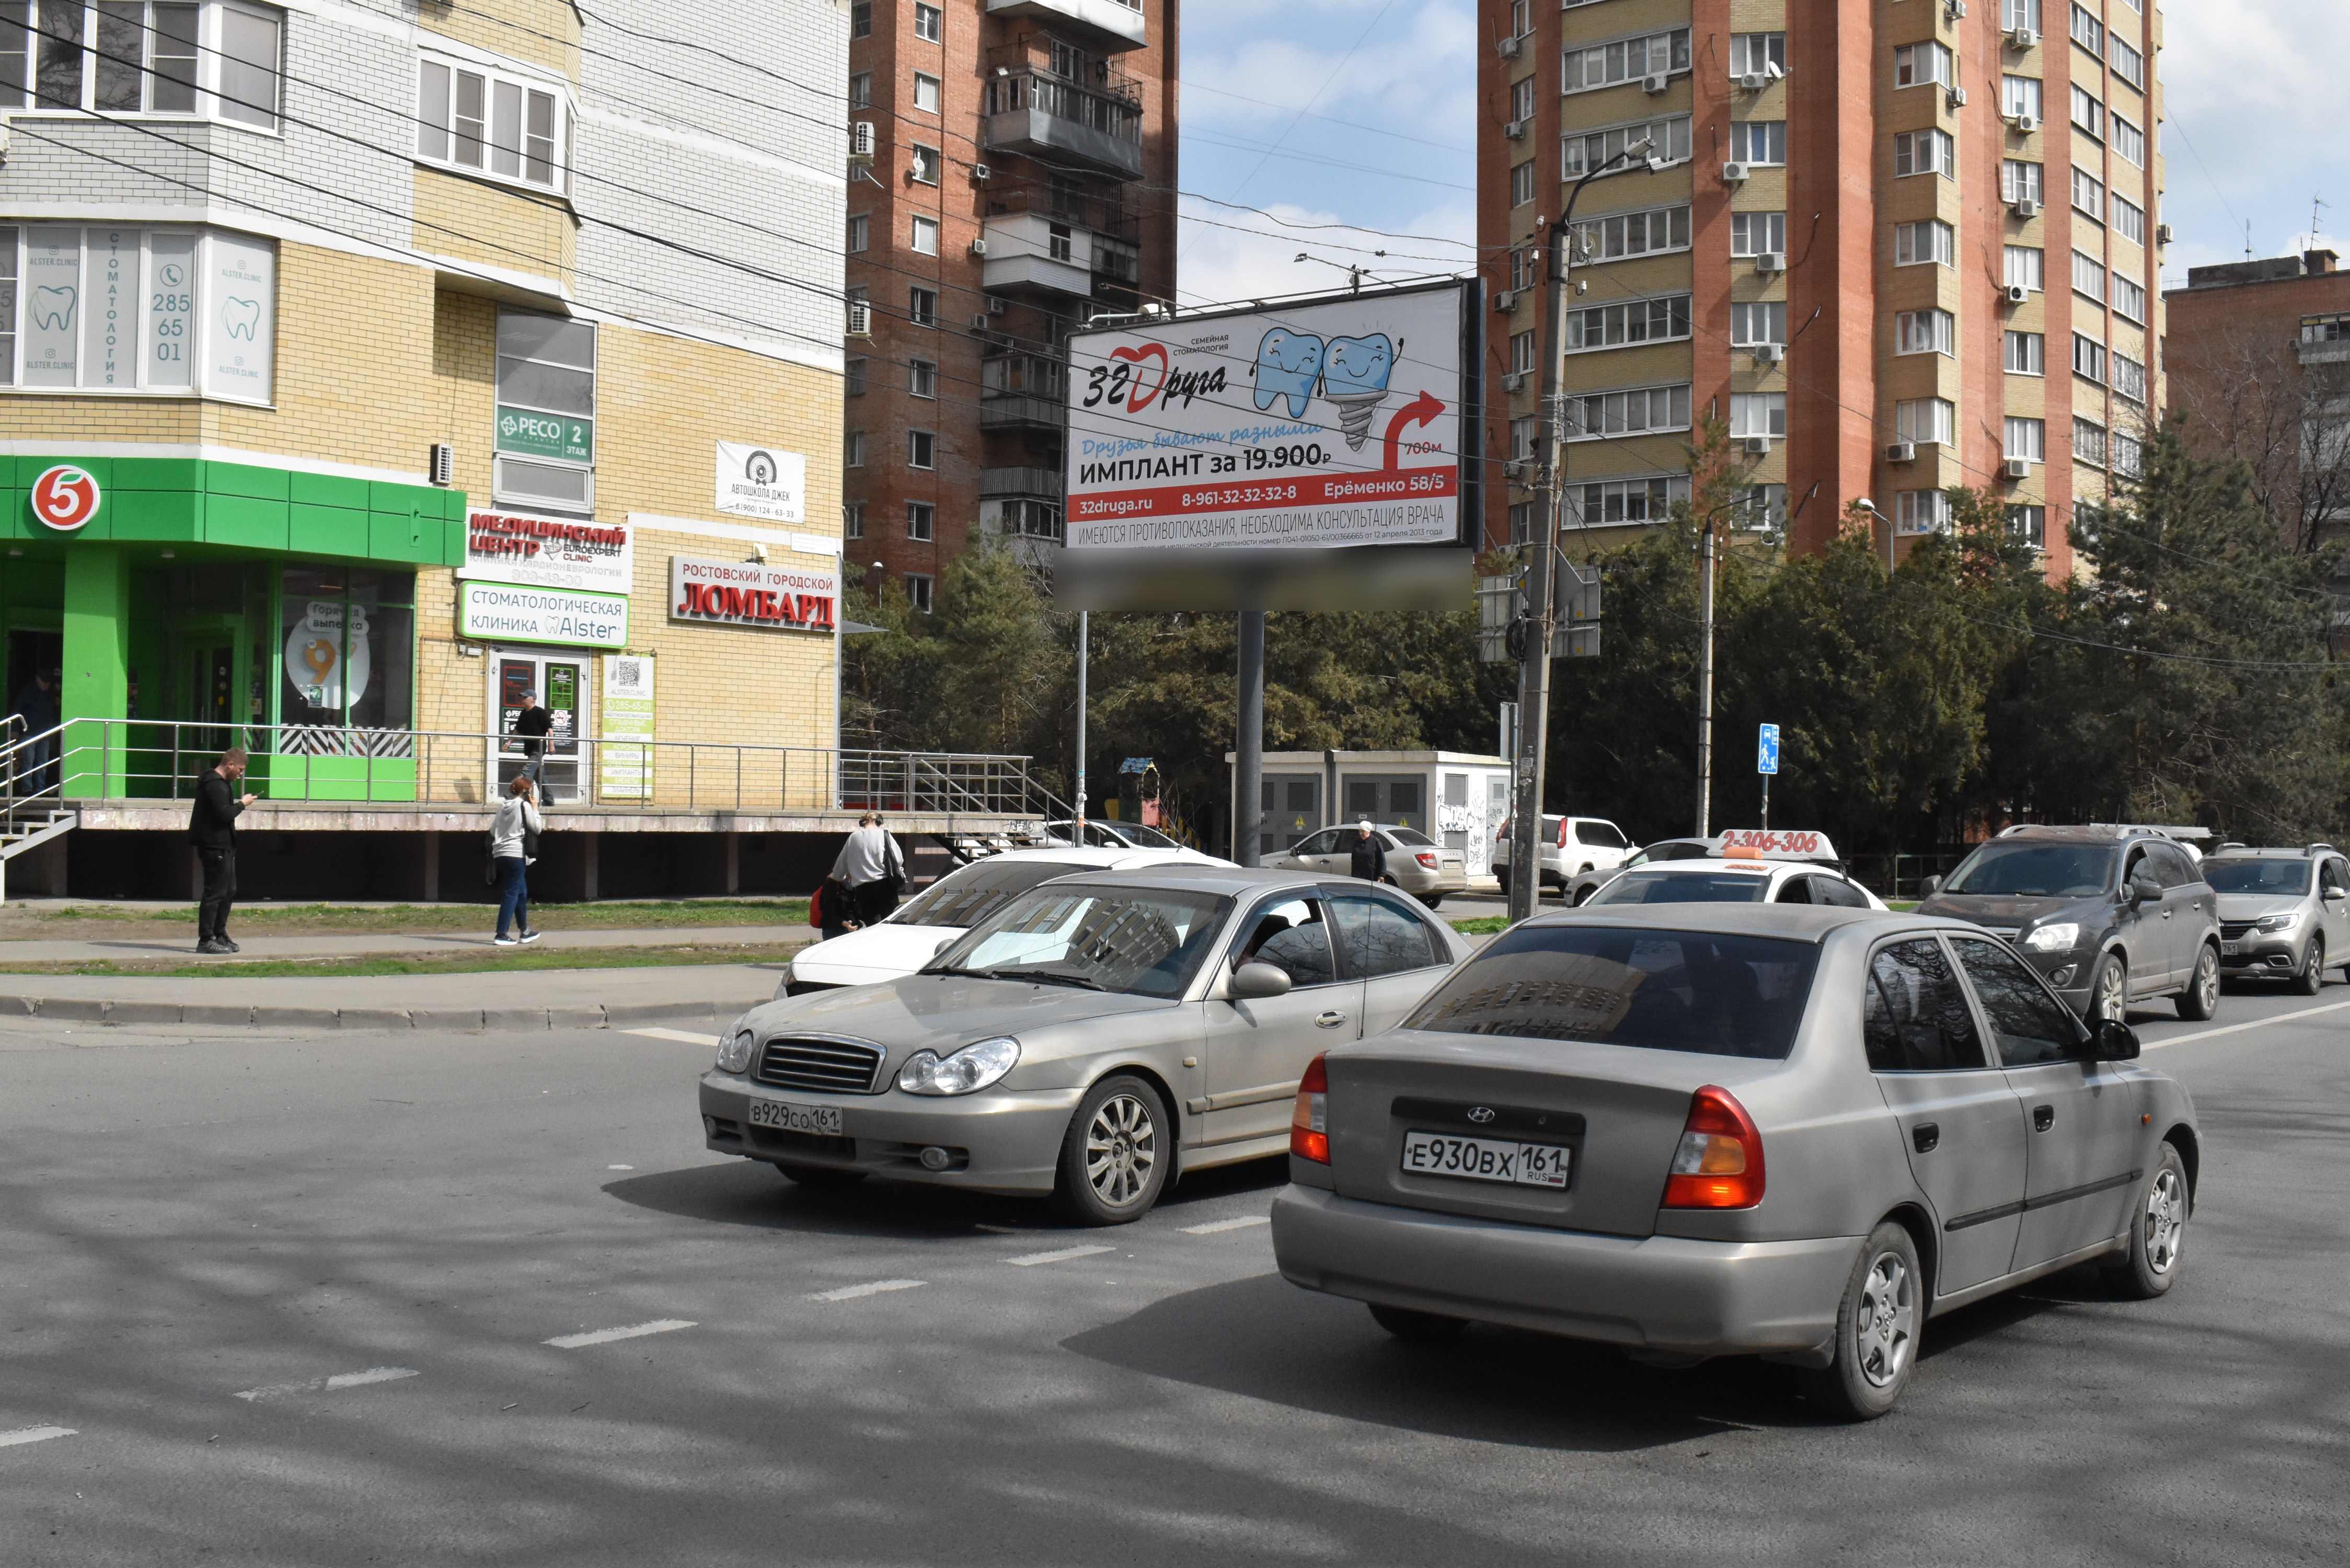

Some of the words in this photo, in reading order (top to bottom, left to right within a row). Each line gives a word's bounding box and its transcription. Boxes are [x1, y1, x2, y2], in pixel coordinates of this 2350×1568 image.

[29, 258, 78, 266] ALSTER.CLINIC
[222, 269, 261, 283] ALSTER.CLINIC
[106, 233, 119, 384] СТОМАТОЛОГИЯ
[153, 294, 190, 312] 285
[158, 318, 183, 336] 65
[1191, 335, 1229, 345] СЕМЕЙНАЯ
[157, 343, 181, 361] 01
[1173, 344, 1229, 356] СТОМАТОЛОГИЯ
[26, 361, 75, 370] ALSTER.CLINIC
[218, 365, 259, 378] ALSTER.CLINIC
[519, 417, 560, 439] РЕСО
[572, 425, 581, 443] 2
[1082, 439, 1148, 459] Друзья
[1153, 431, 1225, 449] бывают
[1229, 423, 1324, 446] разными
[1405, 442, 1442, 455] 700м
[566, 445, 587, 456] ЭТАЖ
[1080, 454, 1203, 484] ИМПЛАНТ
[1211, 456, 1236, 473] за
[48, 471, 84, 517] 5
[731, 483, 770, 499] АВТОШКОЛА
[771, 489, 790, 502] ДЖЕК
[1324, 481, 1406, 499] Ерёменко
[1410, 473, 1444, 491] 58/5
[1182, 486, 1296, 506] 8-961-32-32-32-8
[741, 503, 757, 513] (900)
[1080, 499, 1152, 514] 32druga.ru
[470, 513, 626, 545] МЕДИЦИНСКИЙ
[1079, 525, 1125, 545] ИМЕЮТСЯ
[1130, 517, 1237, 541] ПРОТИВОПОКАЗАНИЯ,
[1241, 513, 1313, 535] НЕОБХОДИМА
[1317, 508, 1403, 531] КОНСУЛЬТАЦИЯ
[1408, 504, 1444, 525] ВРАЧА
[470, 534, 540, 555] ЦЕНТР
[1213, 537, 1257, 548] деятельности
[1382, 530, 1408, 539] апреля
[563, 544, 622, 558] EUROEXPERT
[563, 553, 593, 563] CLINIC
[683, 563, 761, 583] РОСТОВСКИЙ
[767, 573, 833, 591] ГОРОДСКОЙ
[314, 604, 359, 617] Горяя
[472, 591, 622, 616] СТОМАТОЛОГИЧЕСКАЯ
[678, 582, 835, 630] ЛОМБАРД
[314, 619, 363, 630] выпека
[471, 615, 538, 633] КЛИНИКА
[559, 617, 617, 639] Alster
[616, 701, 651, 710] 285-65-01
[1721, 831, 1818, 853] 2-306-306
[754, 1103, 810, 1128] В929СО
[812, 1109, 836, 1126] 161
[1411, 1138, 1514, 1177] Е930ВХ
[1521, 1146, 1561, 1173] 161
[1527, 1171, 1548, 1182] RUS
